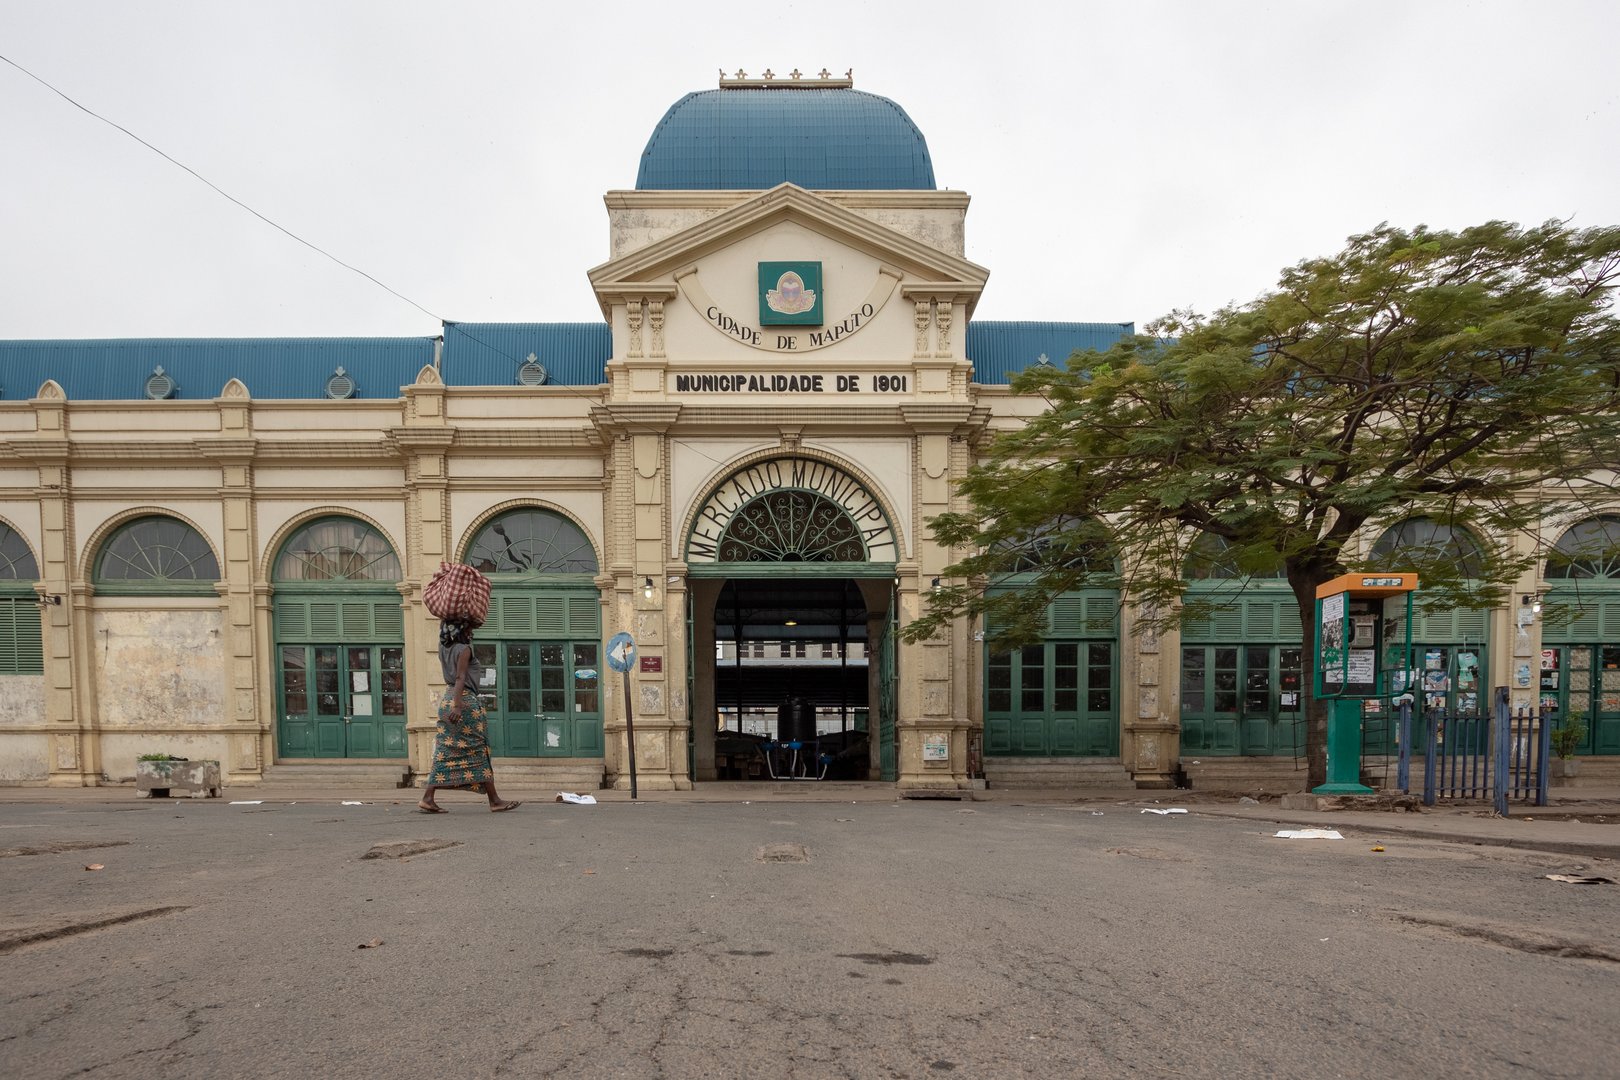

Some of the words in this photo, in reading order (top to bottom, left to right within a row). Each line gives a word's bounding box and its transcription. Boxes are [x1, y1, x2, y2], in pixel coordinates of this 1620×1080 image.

[706, 306, 762, 346] CIDADE
[777, 335, 798, 350] DE
[809, 303, 874, 347] MAPUTO
[676, 375, 824, 393] MUNICIPALIDADE
[836, 375, 860, 392] DE
[873, 375, 907, 392] 1901
[689, 461, 783, 558] MERCADO
[791, 458, 894, 558] MUNICIPAL
